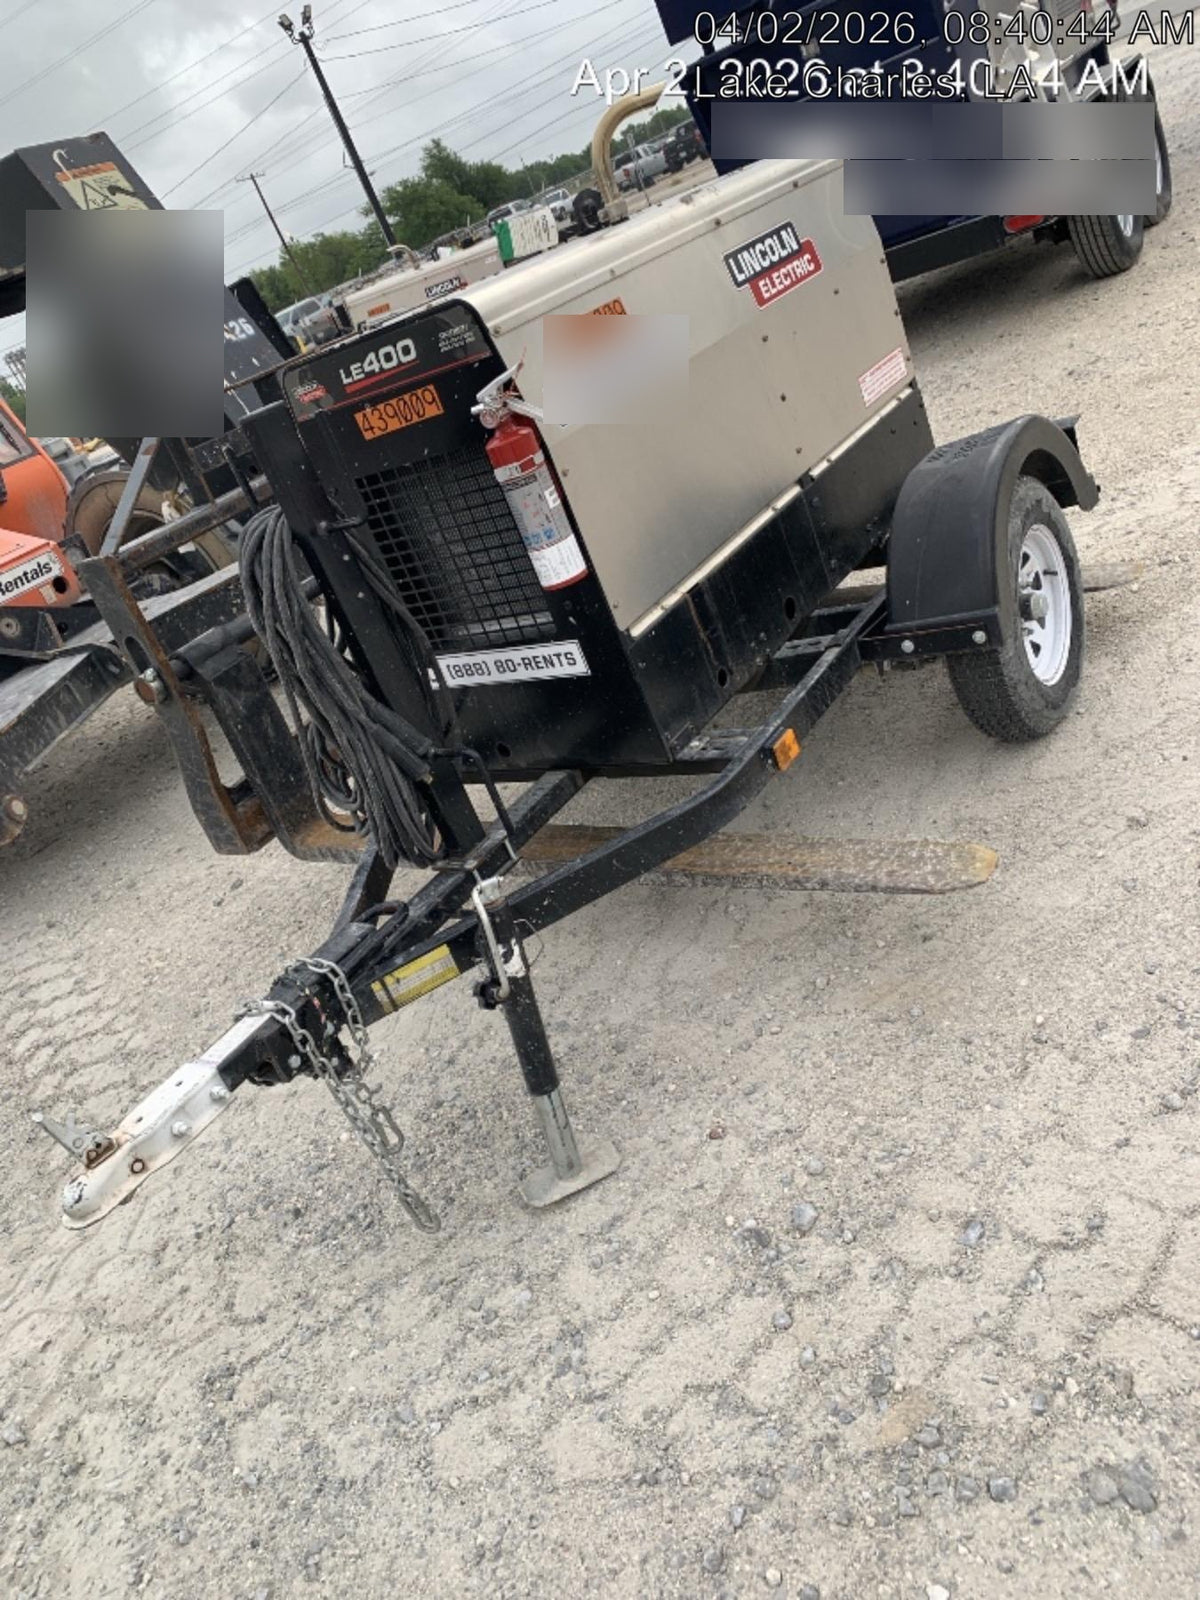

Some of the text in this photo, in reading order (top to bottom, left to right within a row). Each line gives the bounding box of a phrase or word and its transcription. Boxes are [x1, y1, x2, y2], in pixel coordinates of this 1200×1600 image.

[728, 227, 800, 282] LINCOLN
[758, 253, 816, 299] ELECTRIC
[339, 337, 417, 386] LE400
[359, 388, 443, 437] 439009
[446, 651, 578, 680] (888) 80-RENTS
